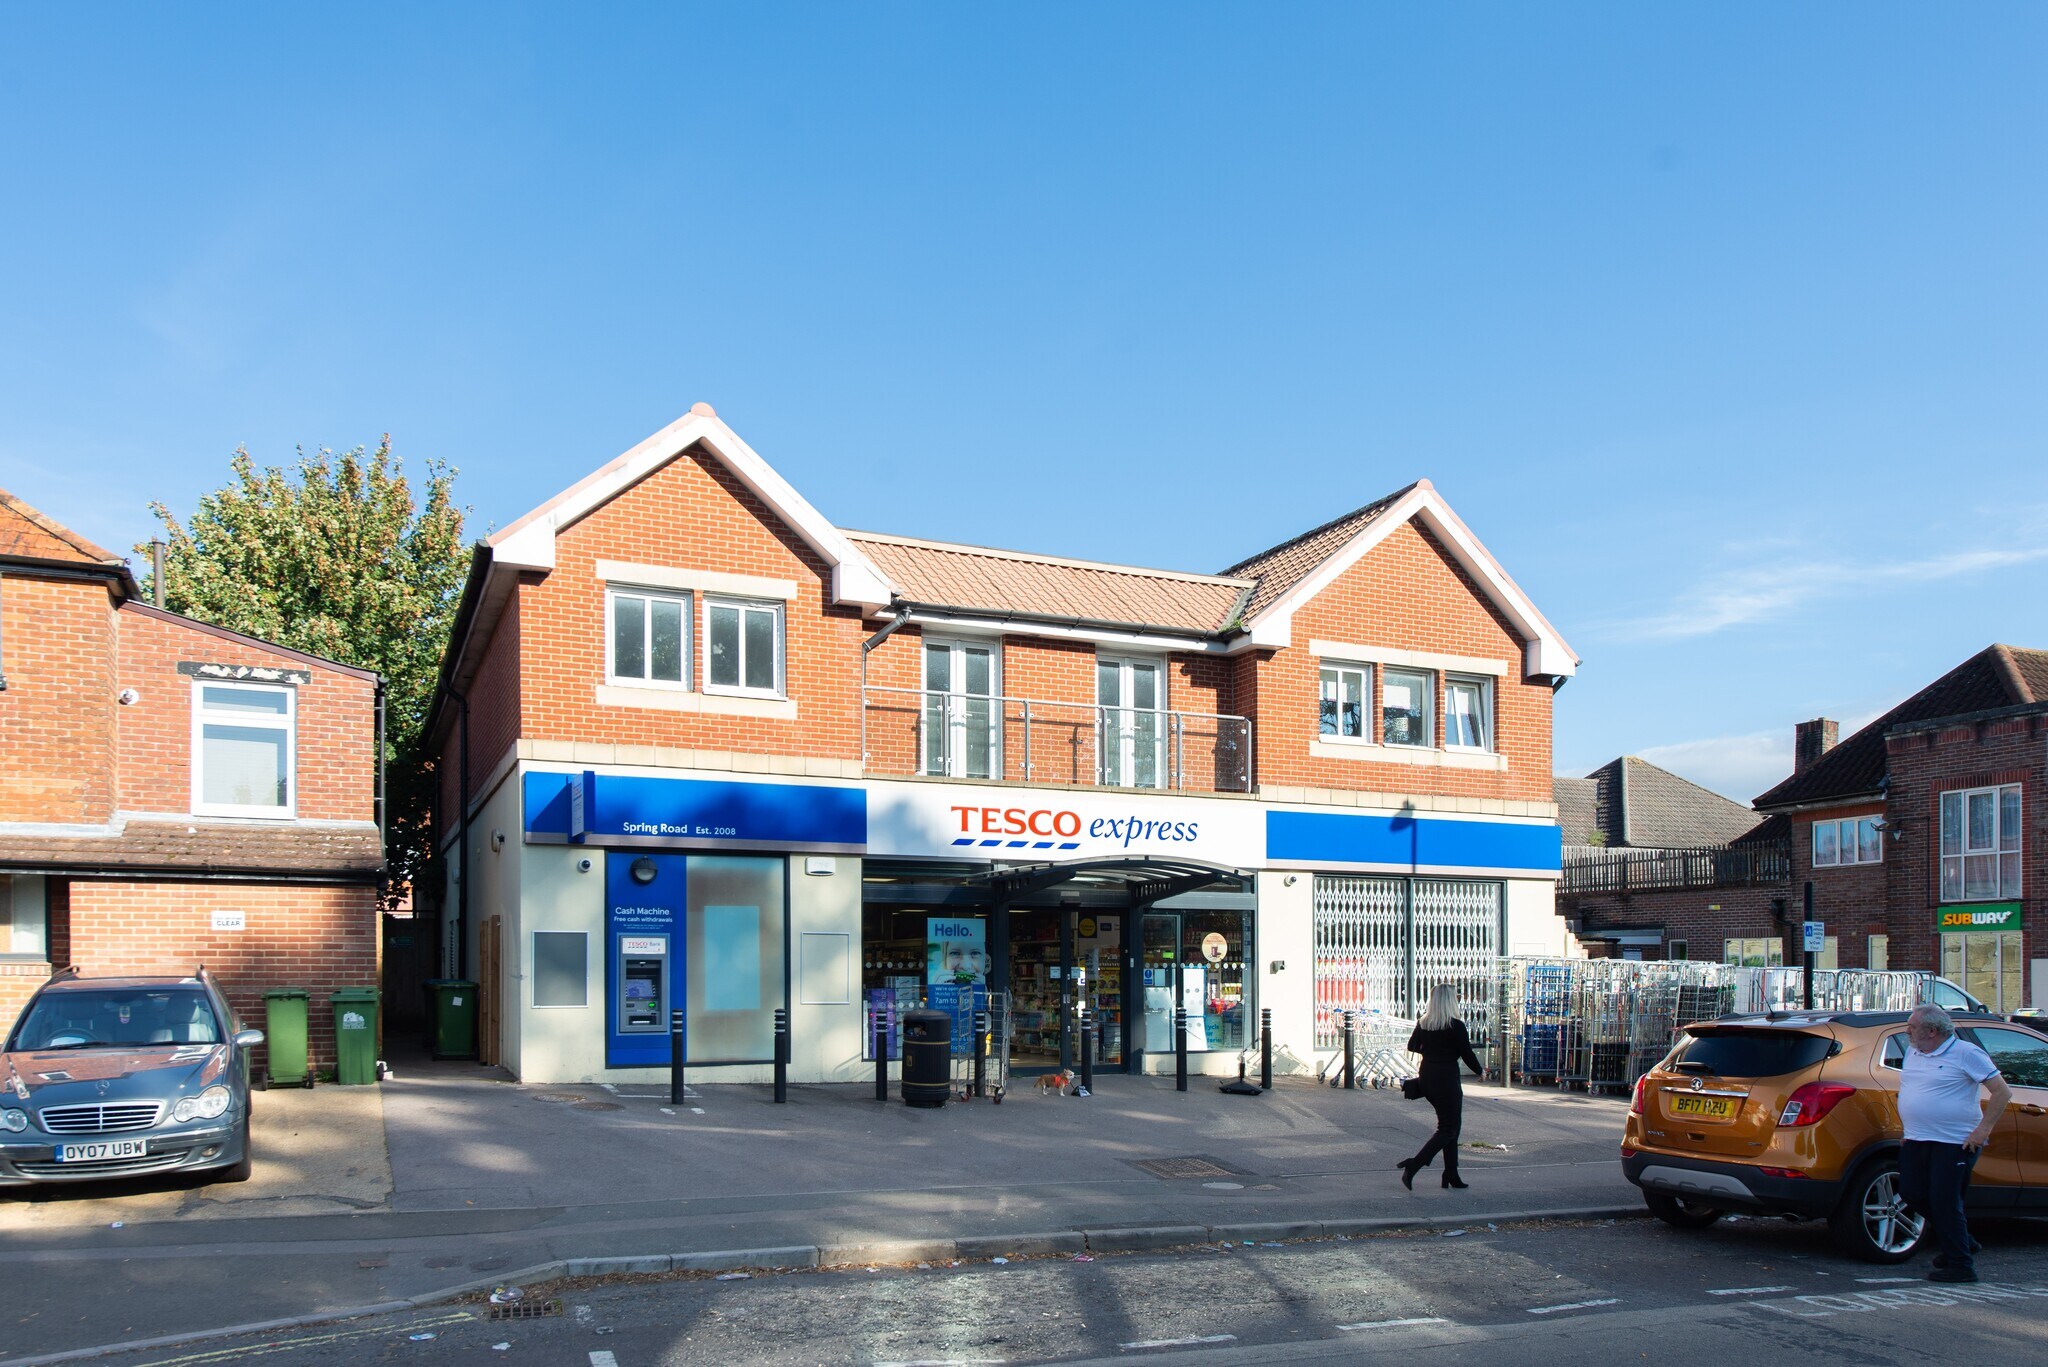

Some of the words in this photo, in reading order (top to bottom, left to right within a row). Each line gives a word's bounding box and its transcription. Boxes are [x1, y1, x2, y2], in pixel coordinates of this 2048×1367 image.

[623, 822, 659, 835] Spring
[660, 823, 688, 834] Road
[695, 826, 712, 835] Est.
[714, 827, 736, 836] 2008
[951, 806, 1082, 837] TESCO
[1089, 815, 1198, 848] express
[615, 906, 635, 915] Cash
[1941, 911, 2013, 926] SUBWAY
[934, 923, 973, 937] Hello.
[1677, 1098, 1701, 1112] BF17
[66, 1145, 107, 1158] OY07
[112, 1141, 144, 1155] UBW
